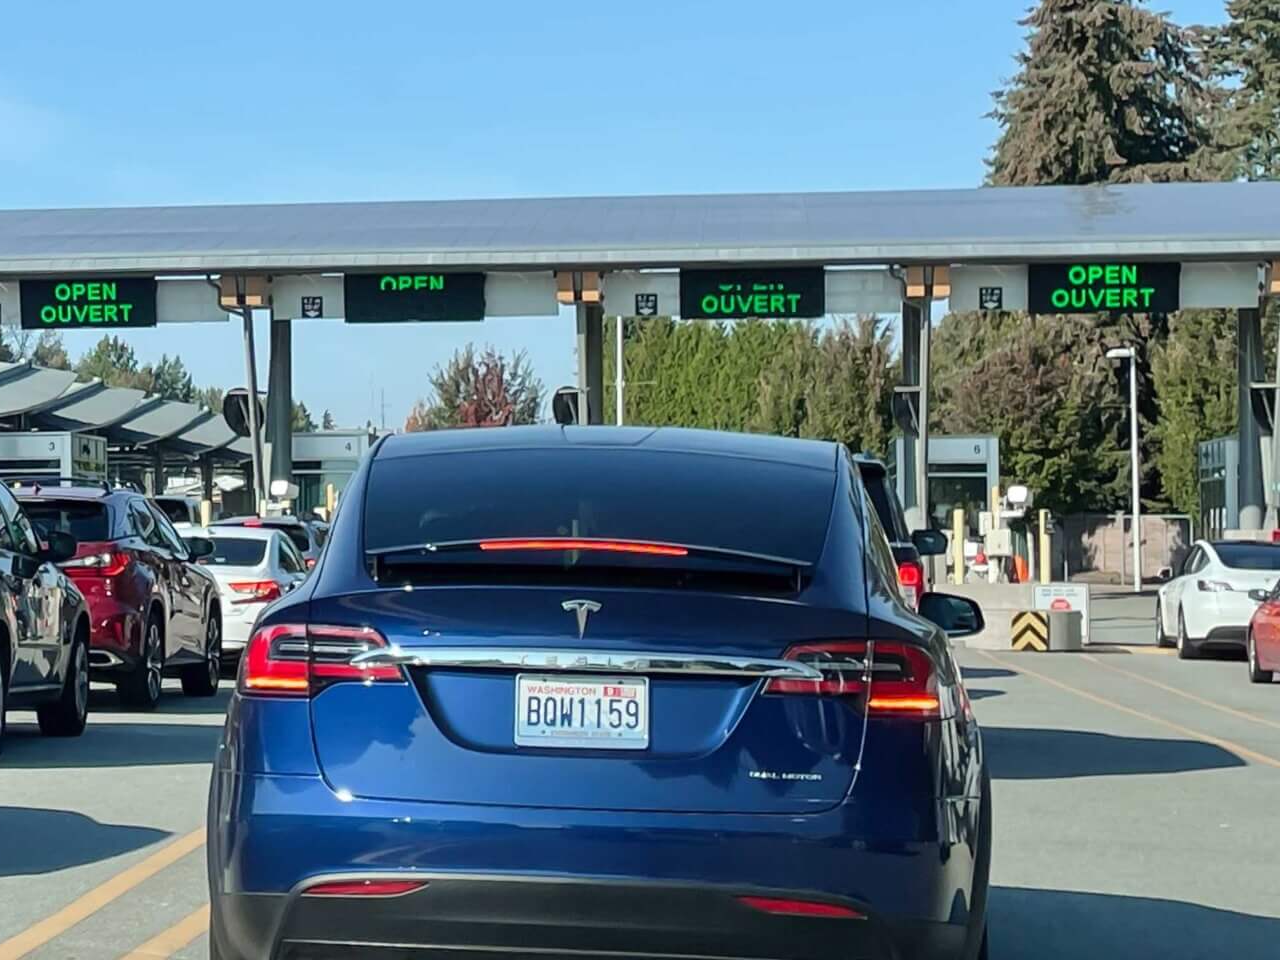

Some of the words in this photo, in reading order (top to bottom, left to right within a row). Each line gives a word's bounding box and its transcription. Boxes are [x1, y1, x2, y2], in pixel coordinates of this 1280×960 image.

[1069, 265, 1137, 285] OPEN
[55, 282, 117, 301] OPEN
[1051, 287, 1155, 308] OUVERT
[40, 303, 133, 323] OUVERT
[701, 294, 801, 314] OUVERT
[48, 441, 56, 452] 3
[527, 685, 597, 697] WASHINGTON
[527, 696, 640, 730] BQW1159
